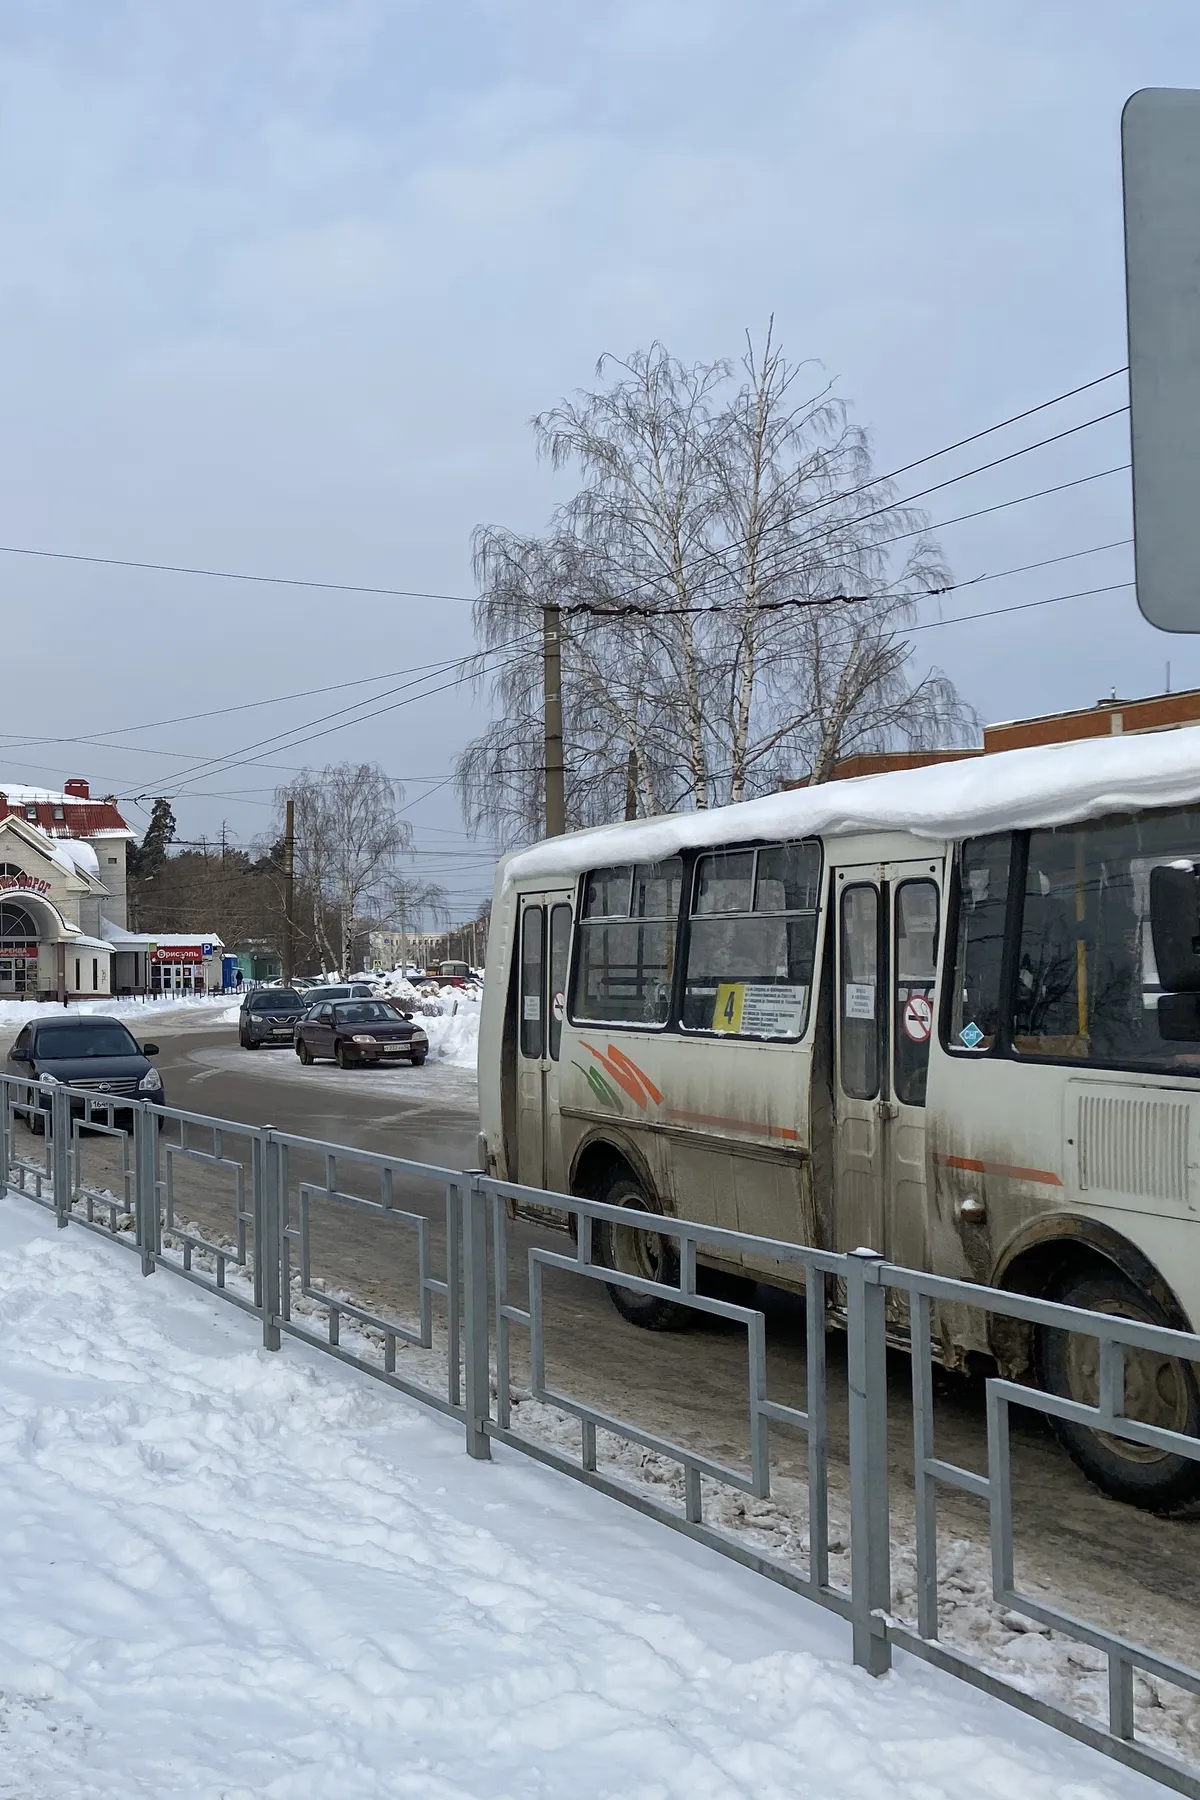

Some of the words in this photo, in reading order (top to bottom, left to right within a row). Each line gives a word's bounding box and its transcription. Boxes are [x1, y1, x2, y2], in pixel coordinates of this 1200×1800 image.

[18, 875, 51, 893] ДОРОГ
[157, 949, 199, 959] Брисоль
[724, 991, 735, 1024] 4
[964, 1030, 978, 1039] СНГ
